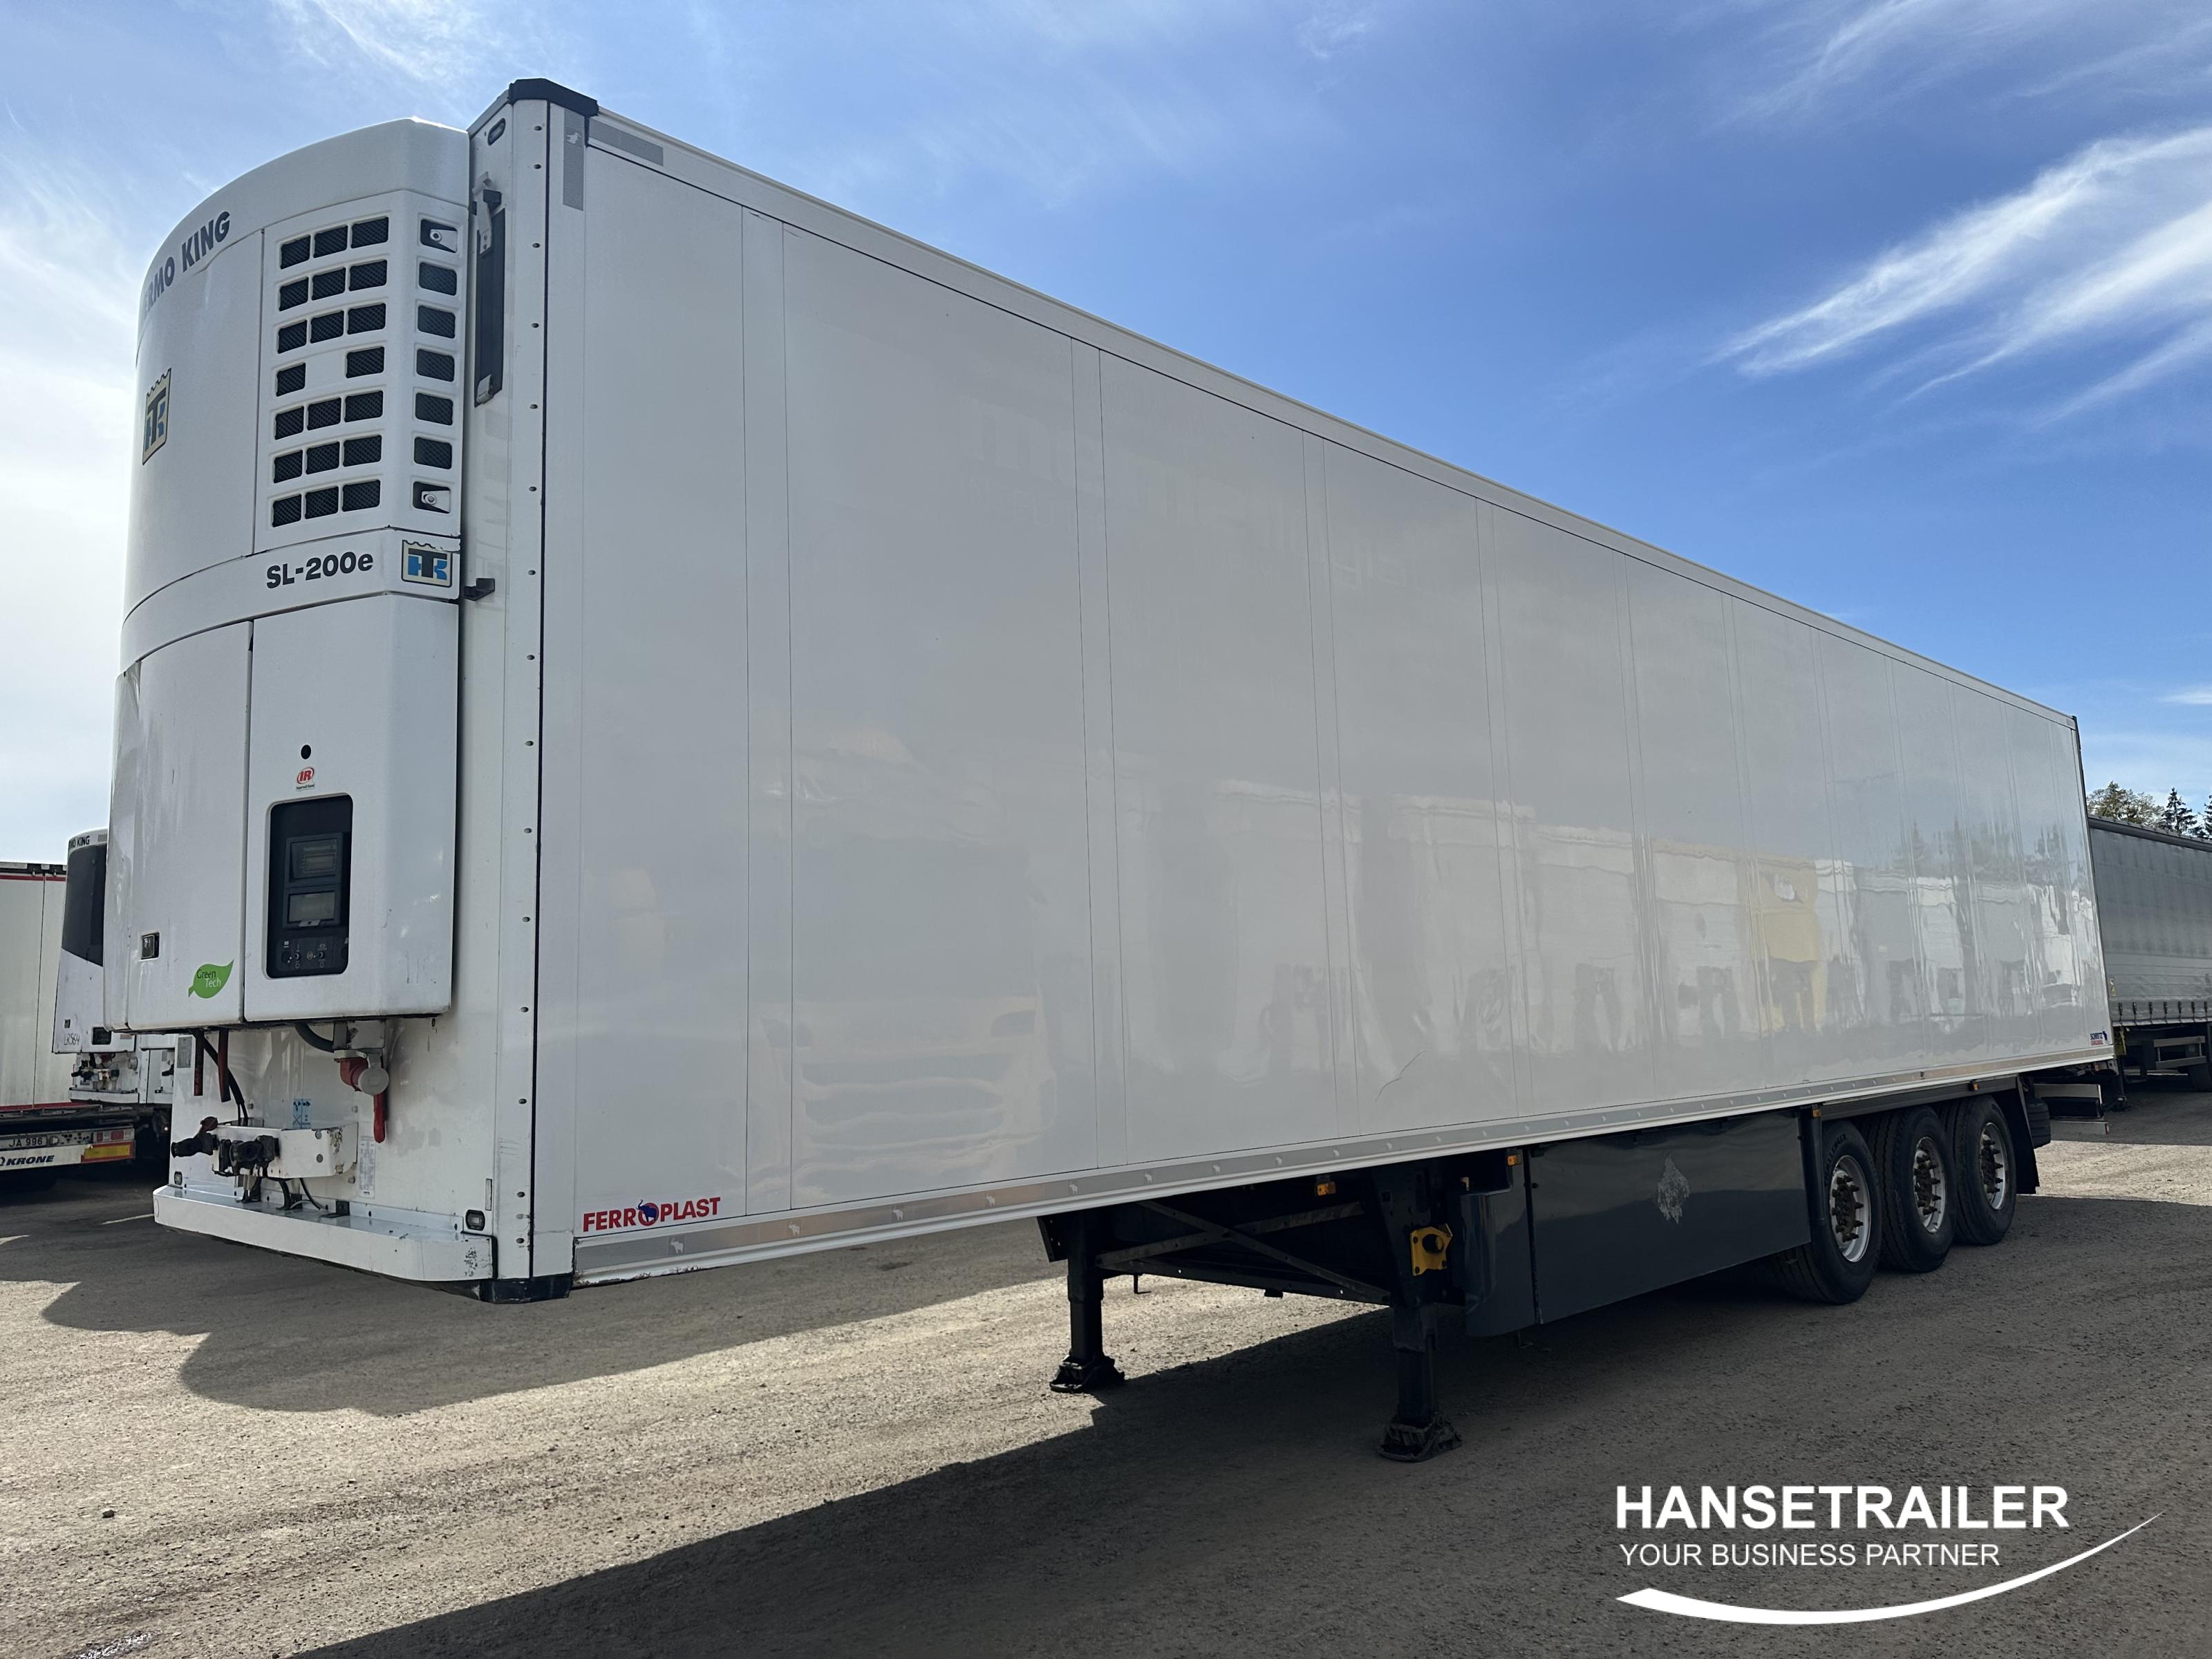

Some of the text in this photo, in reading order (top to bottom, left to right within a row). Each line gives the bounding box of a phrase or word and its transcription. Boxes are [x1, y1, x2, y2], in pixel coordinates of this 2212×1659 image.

[182, 211, 230, 272] KING
[266, 552, 373, 589] SL-200e
[77, 835, 90, 847] KING
[196, 968, 216, 979] Green
[205, 977, 221, 988] Tech
[8, 1138, 22, 1147] JA
[6, 1155, 55, 1166] KRONE
[583, 1197, 721, 1232] FERROPLAST
